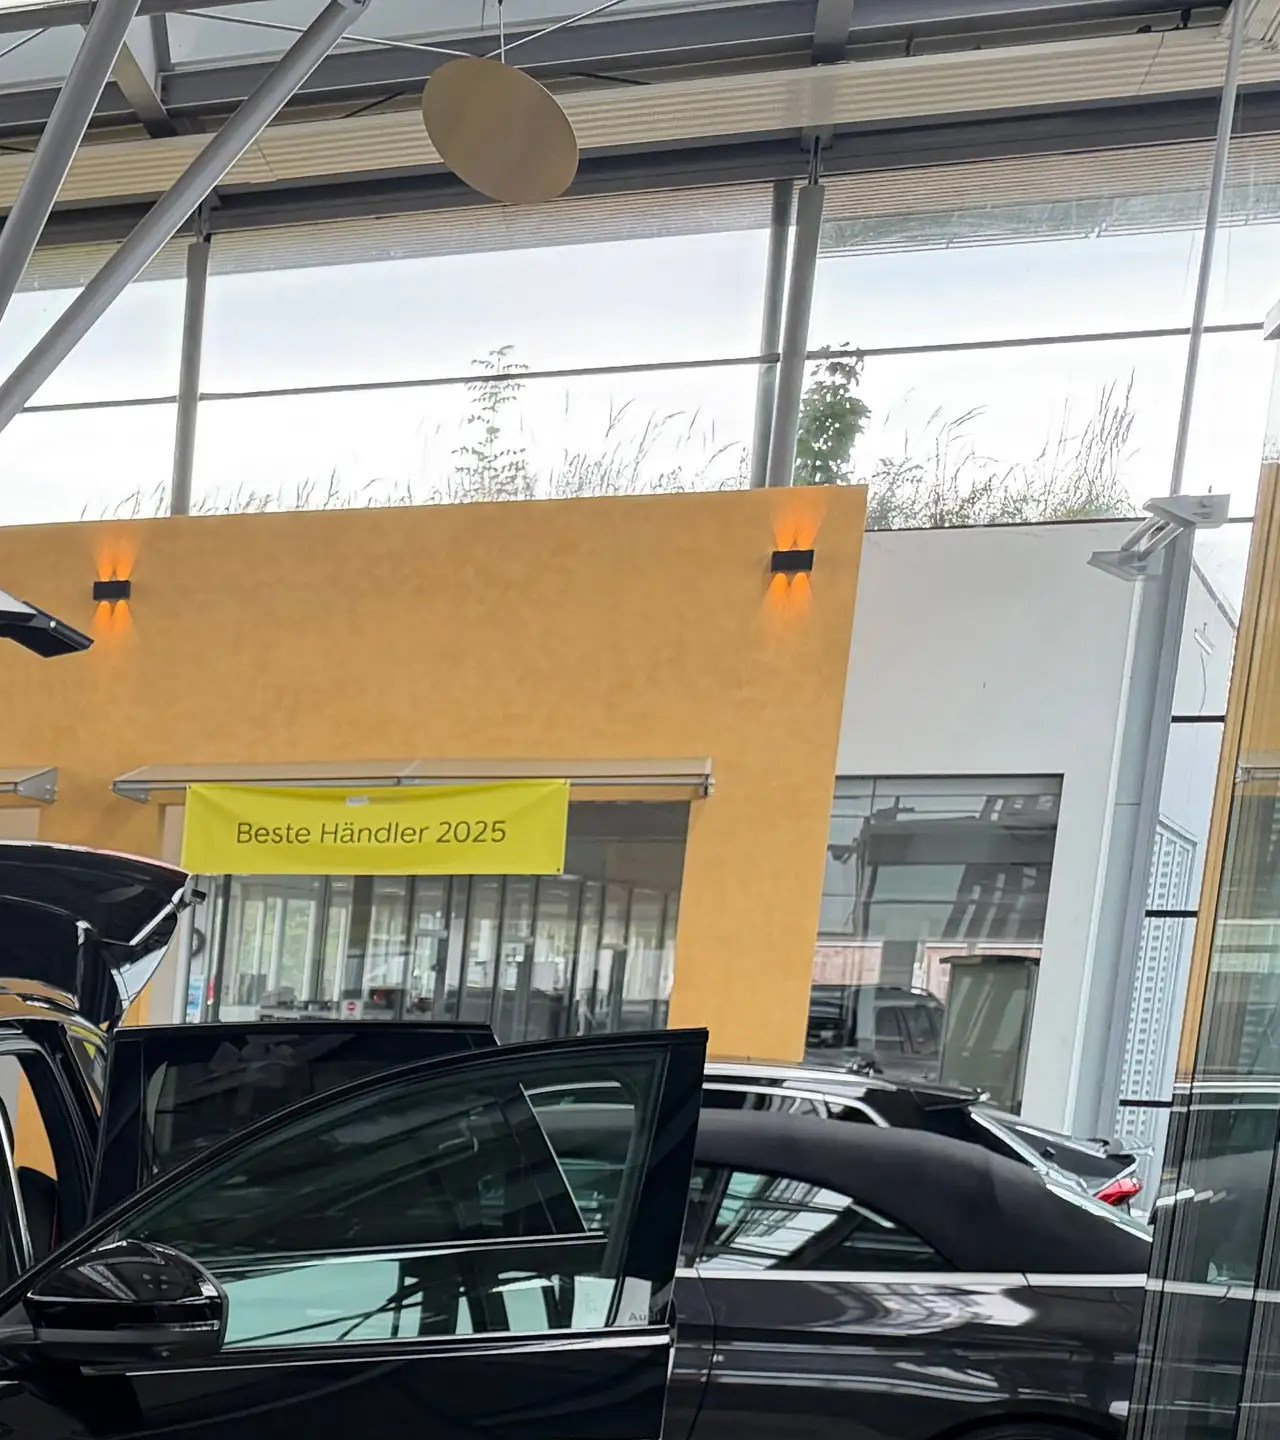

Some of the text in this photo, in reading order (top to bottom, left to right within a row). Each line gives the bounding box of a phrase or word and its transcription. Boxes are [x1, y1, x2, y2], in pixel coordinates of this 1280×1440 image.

[238, 820, 506, 845] Beste Händler 2025
